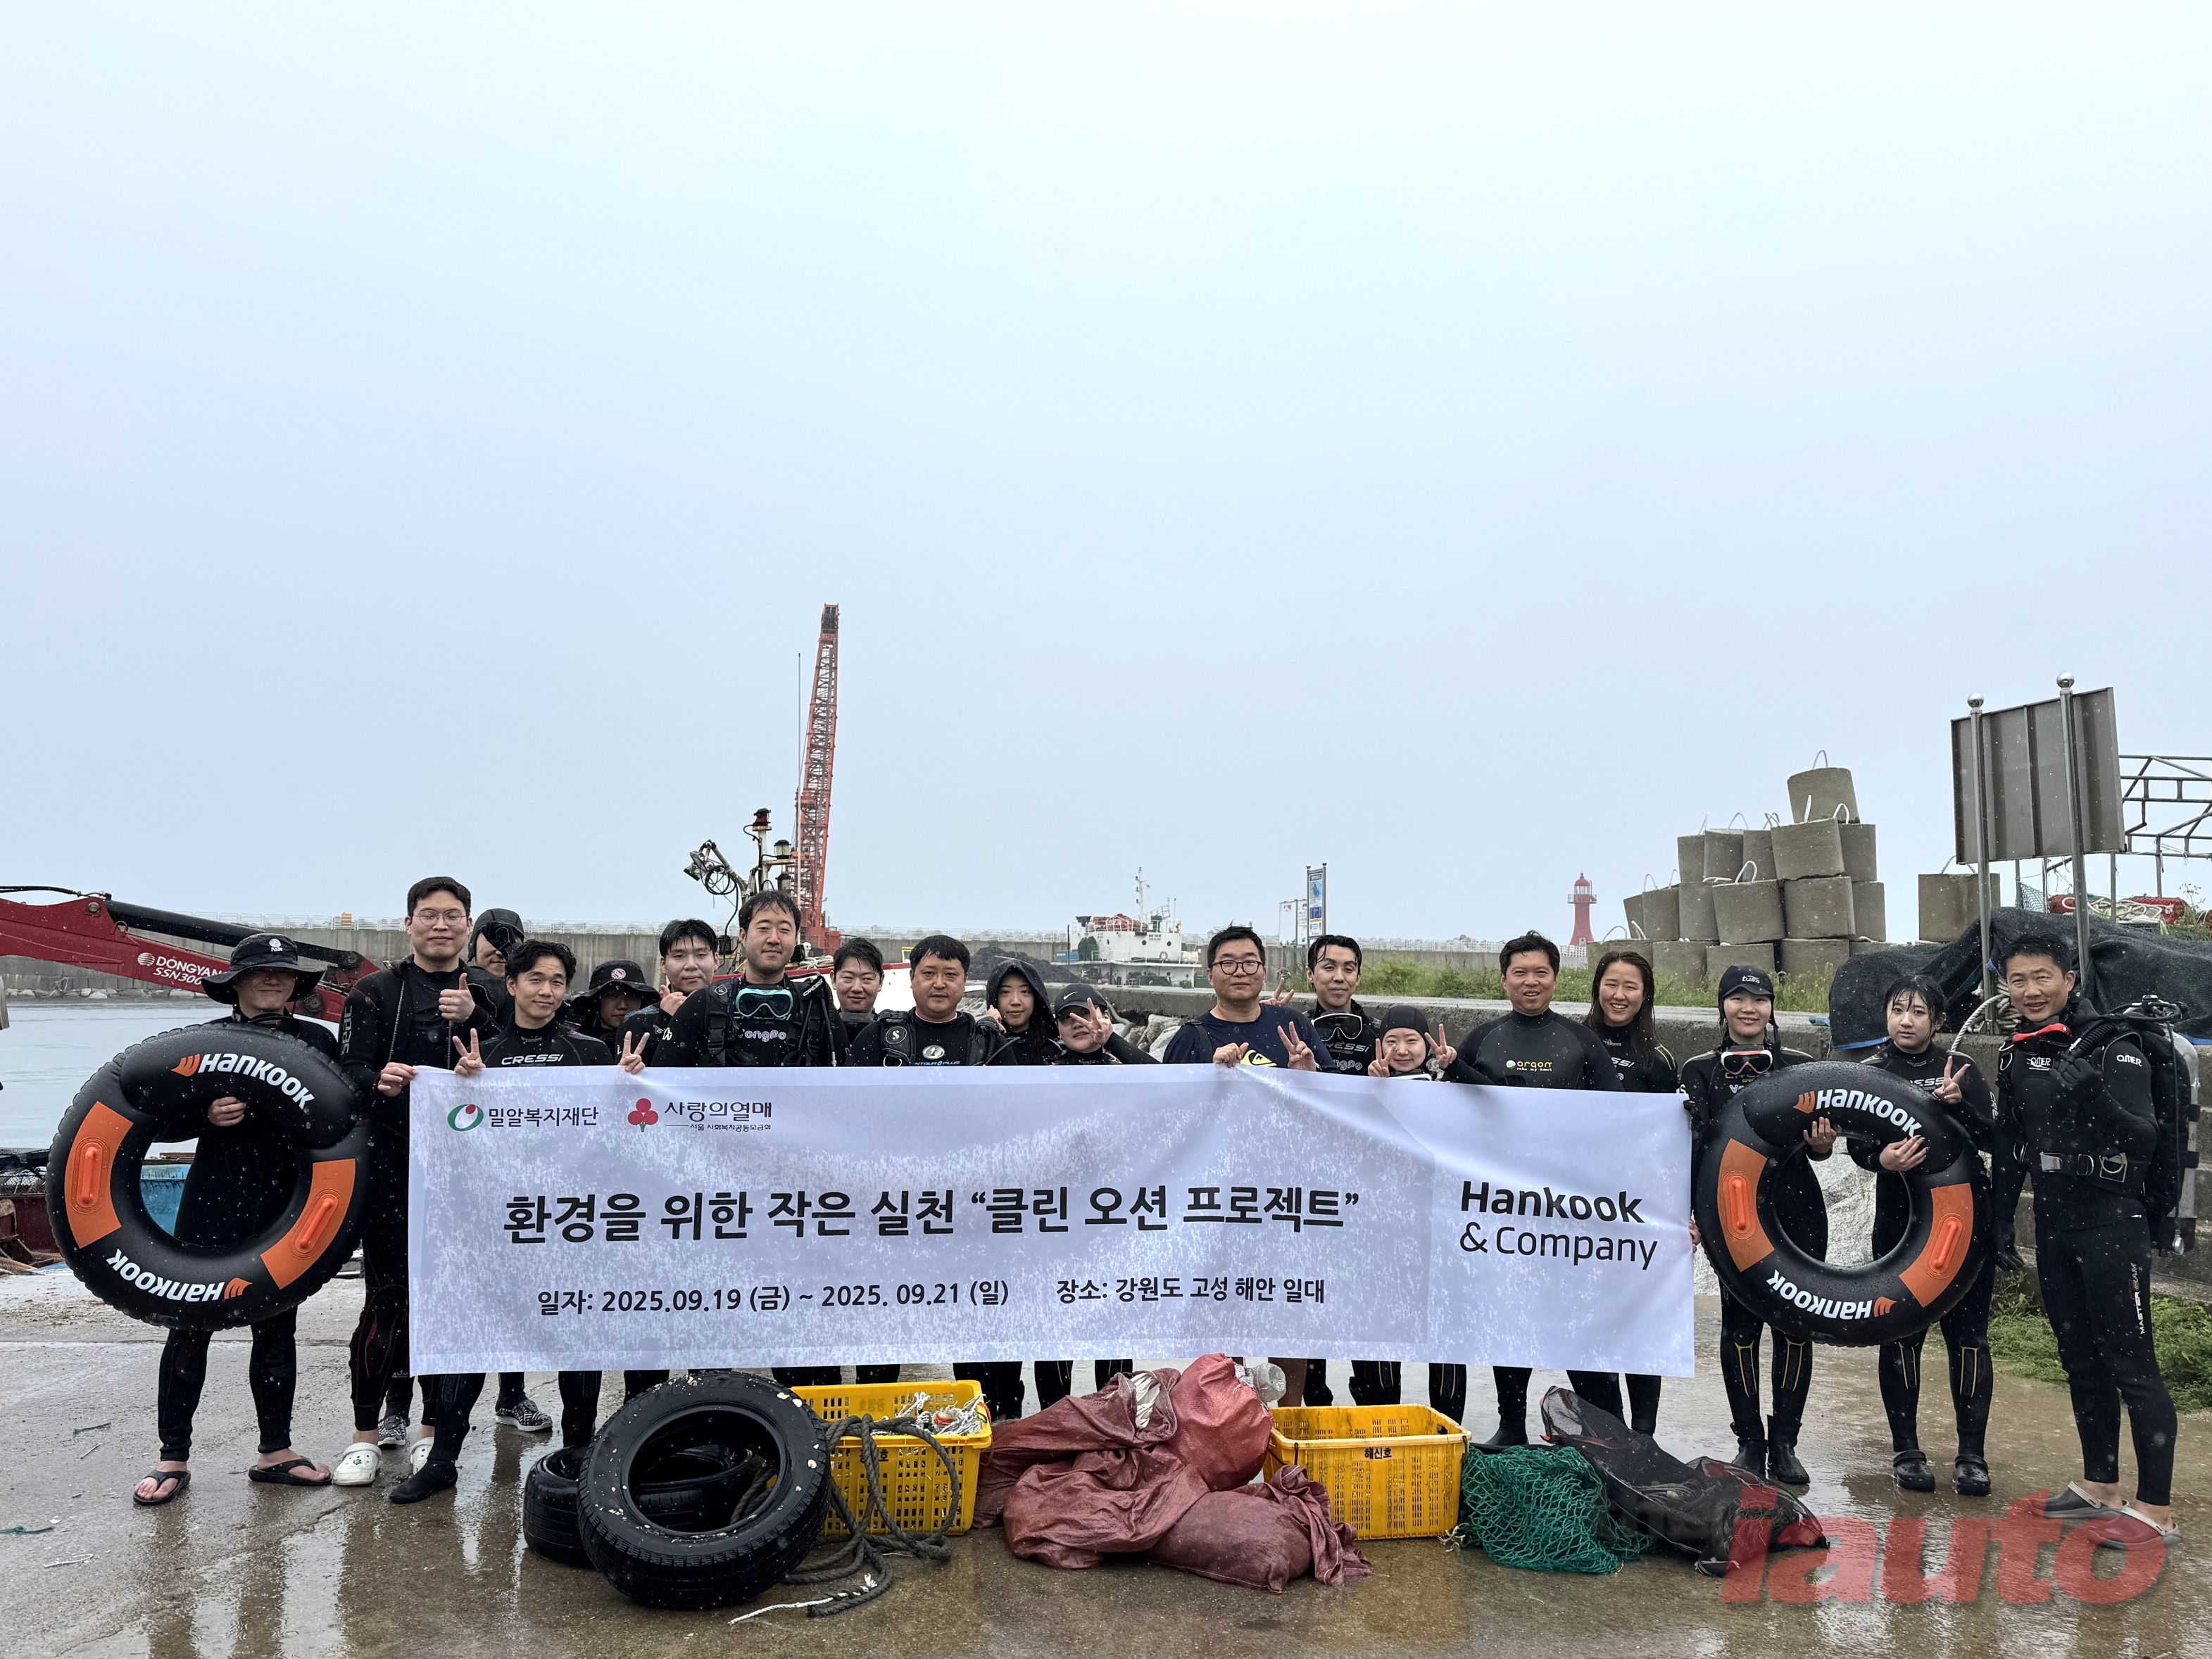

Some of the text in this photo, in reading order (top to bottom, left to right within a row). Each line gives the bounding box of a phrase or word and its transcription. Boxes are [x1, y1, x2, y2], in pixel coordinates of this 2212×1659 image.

[156, 956, 229, 977] DONGYAN
[1326, 1041, 1369, 1053] RESSI
[501, 1054, 564, 1066] CRESSI
[489, 1106, 598, 1128] 밀알복지재단
[665, 1102, 772, 1122] 사랑의열매
[1461, 1180, 1645, 1223] Hankook
[504, 1194, 646, 1243] 환경을
[660, 1192, 753, 1241] 위한
[768, 1191, 856, 1238] 작은
[871, 1190, 954, 1236] 실천
[1084, 1185, 1168, 1231] 오션
[1496, 1226, 1658, 1270] Company
[538, 1289, 593, 1315] 일자:
[601, 1289, 741, 1313] 2025.09.19
[749, 1285, 790, 1312] (금)
[969, 1280, 1009, 1306] (일)
[1056, 1276, 1324, 1304] 장소: 강원도 고성 해안 일대
[1364, 1447, 1392, 1459] 해신호
